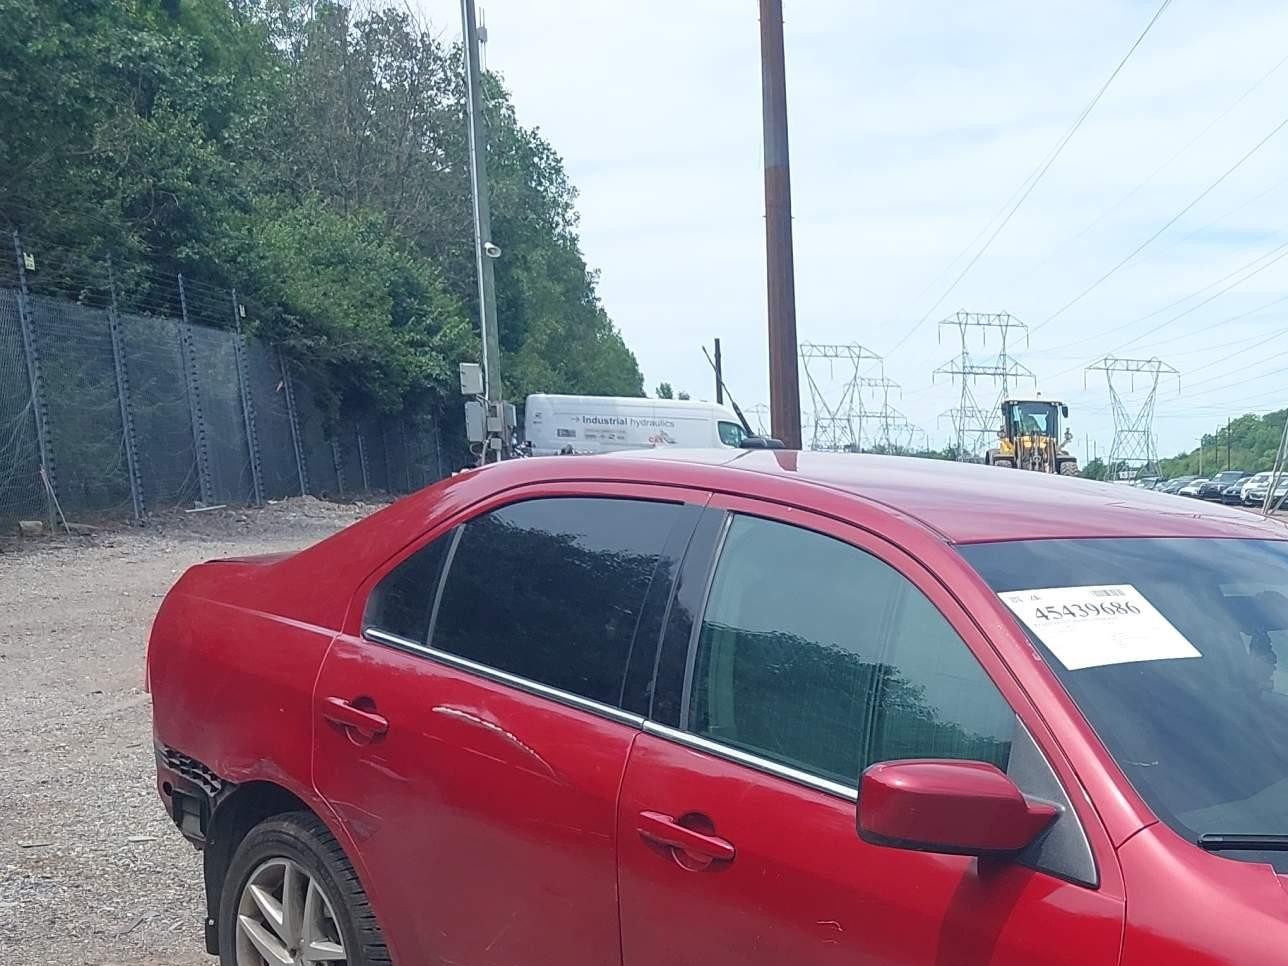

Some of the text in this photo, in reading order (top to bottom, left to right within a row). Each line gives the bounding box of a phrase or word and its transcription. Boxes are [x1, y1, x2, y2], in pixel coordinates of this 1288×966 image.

[582, 415, 675, 429] Industrial hydraulics
[1035, 601, 1141, 620] 45439686
